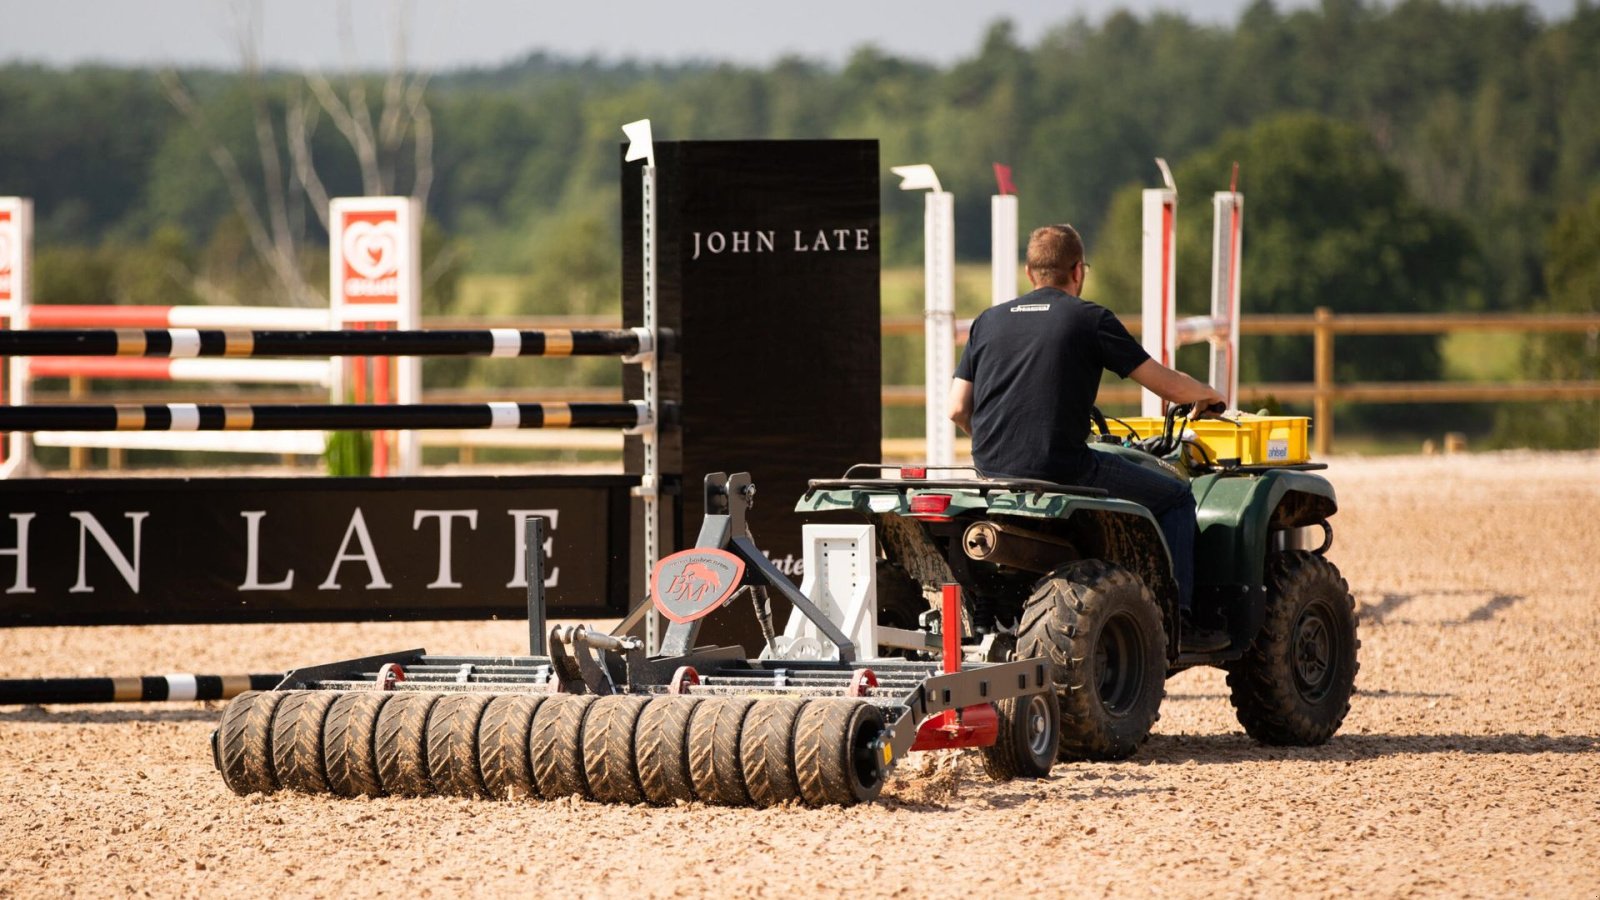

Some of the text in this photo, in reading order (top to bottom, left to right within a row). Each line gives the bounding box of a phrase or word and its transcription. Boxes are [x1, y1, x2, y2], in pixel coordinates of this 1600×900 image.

[692, 228, 870, 261] JOHN LATE
[237, 507, 561, 591] LATE
